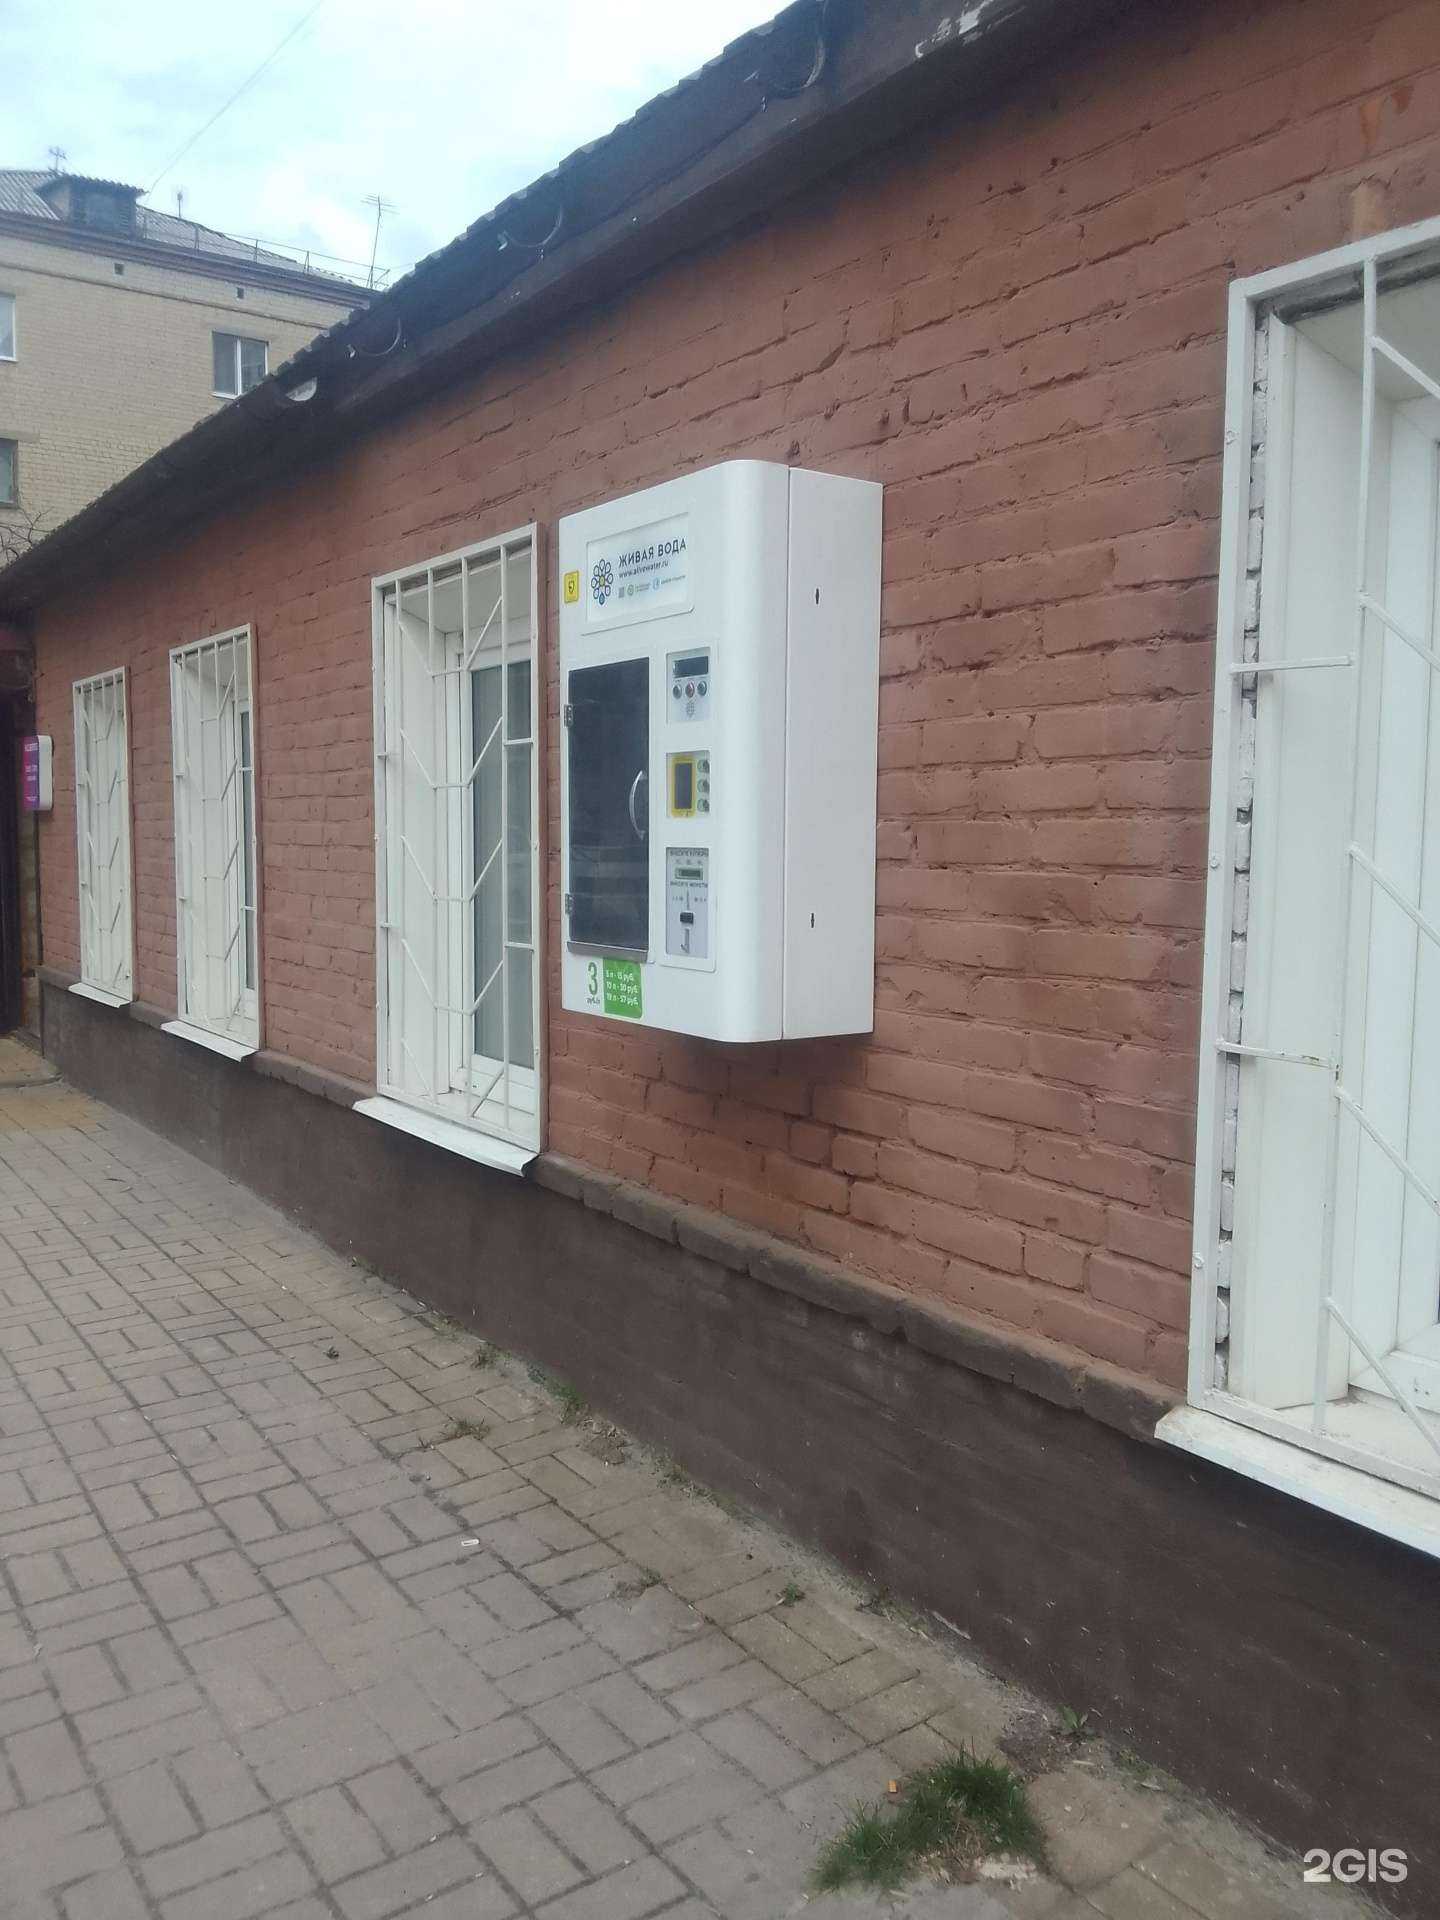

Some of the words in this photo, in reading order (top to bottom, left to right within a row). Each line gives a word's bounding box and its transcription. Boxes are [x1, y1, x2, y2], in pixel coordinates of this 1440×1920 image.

[618, 546, 654, 568] ЖИВАЯ
[658, 538, 687, 557] ВОДА
[588, 961, 598, 996] 3
